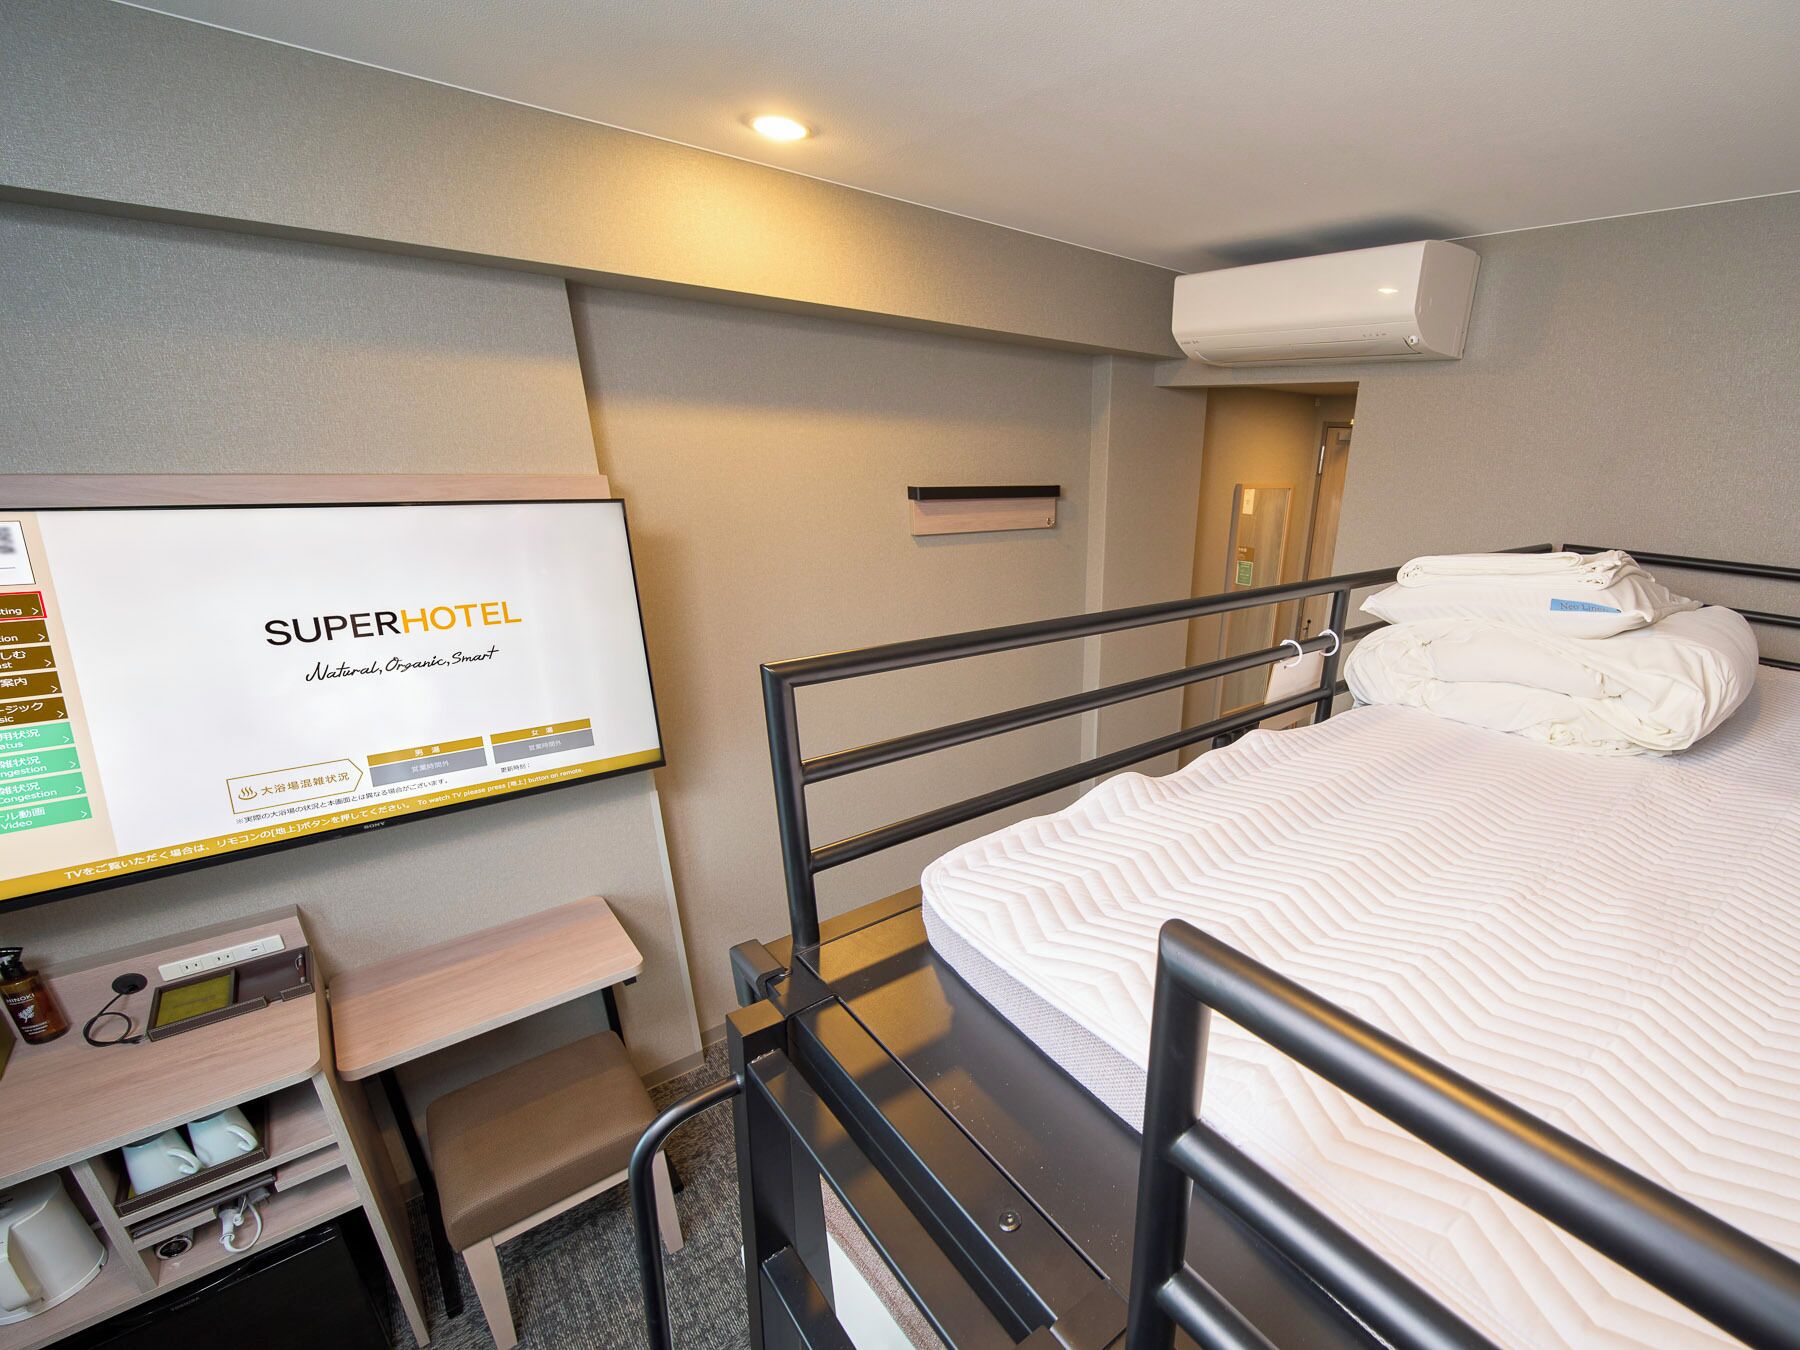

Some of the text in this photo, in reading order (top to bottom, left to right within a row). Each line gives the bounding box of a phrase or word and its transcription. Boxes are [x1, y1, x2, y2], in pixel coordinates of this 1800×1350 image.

[1560, 601, 1578, 610] Neo
[264, 601, 522, 646] SUPERHOTEL
[261, 772, 350, 796] 大浴場混雑状況
[429, 795, 450, 805] watch
[463, 787, 486, 798] please
[487, 784, 506, 794] press
[1, 819, 33, 830] Video
